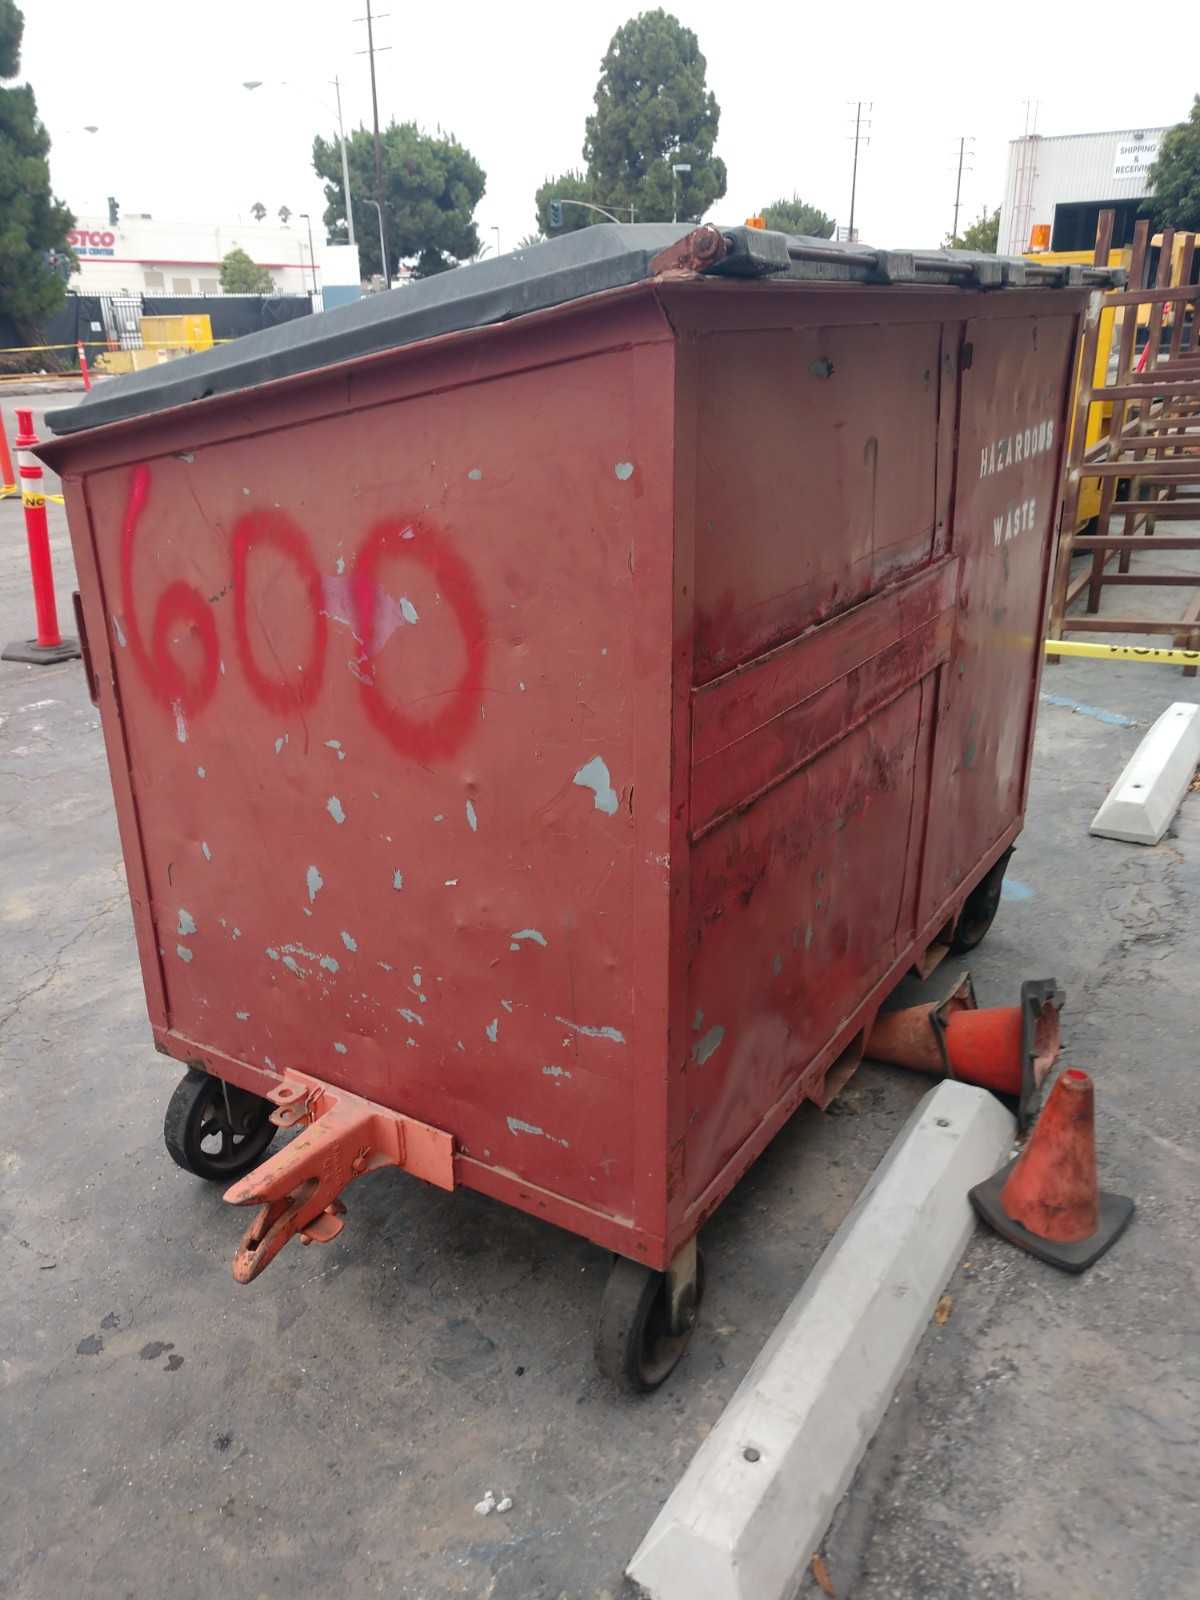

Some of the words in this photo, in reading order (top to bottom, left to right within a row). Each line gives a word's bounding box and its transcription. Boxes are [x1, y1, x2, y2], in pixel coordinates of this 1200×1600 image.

[1120, 144, 1156, 155] SHIPPING
[1115, 164, 1152, 174] RECEIVIN
[993, 498, 1036, 546] WASTE
[120, 463, 490, 764] 600
